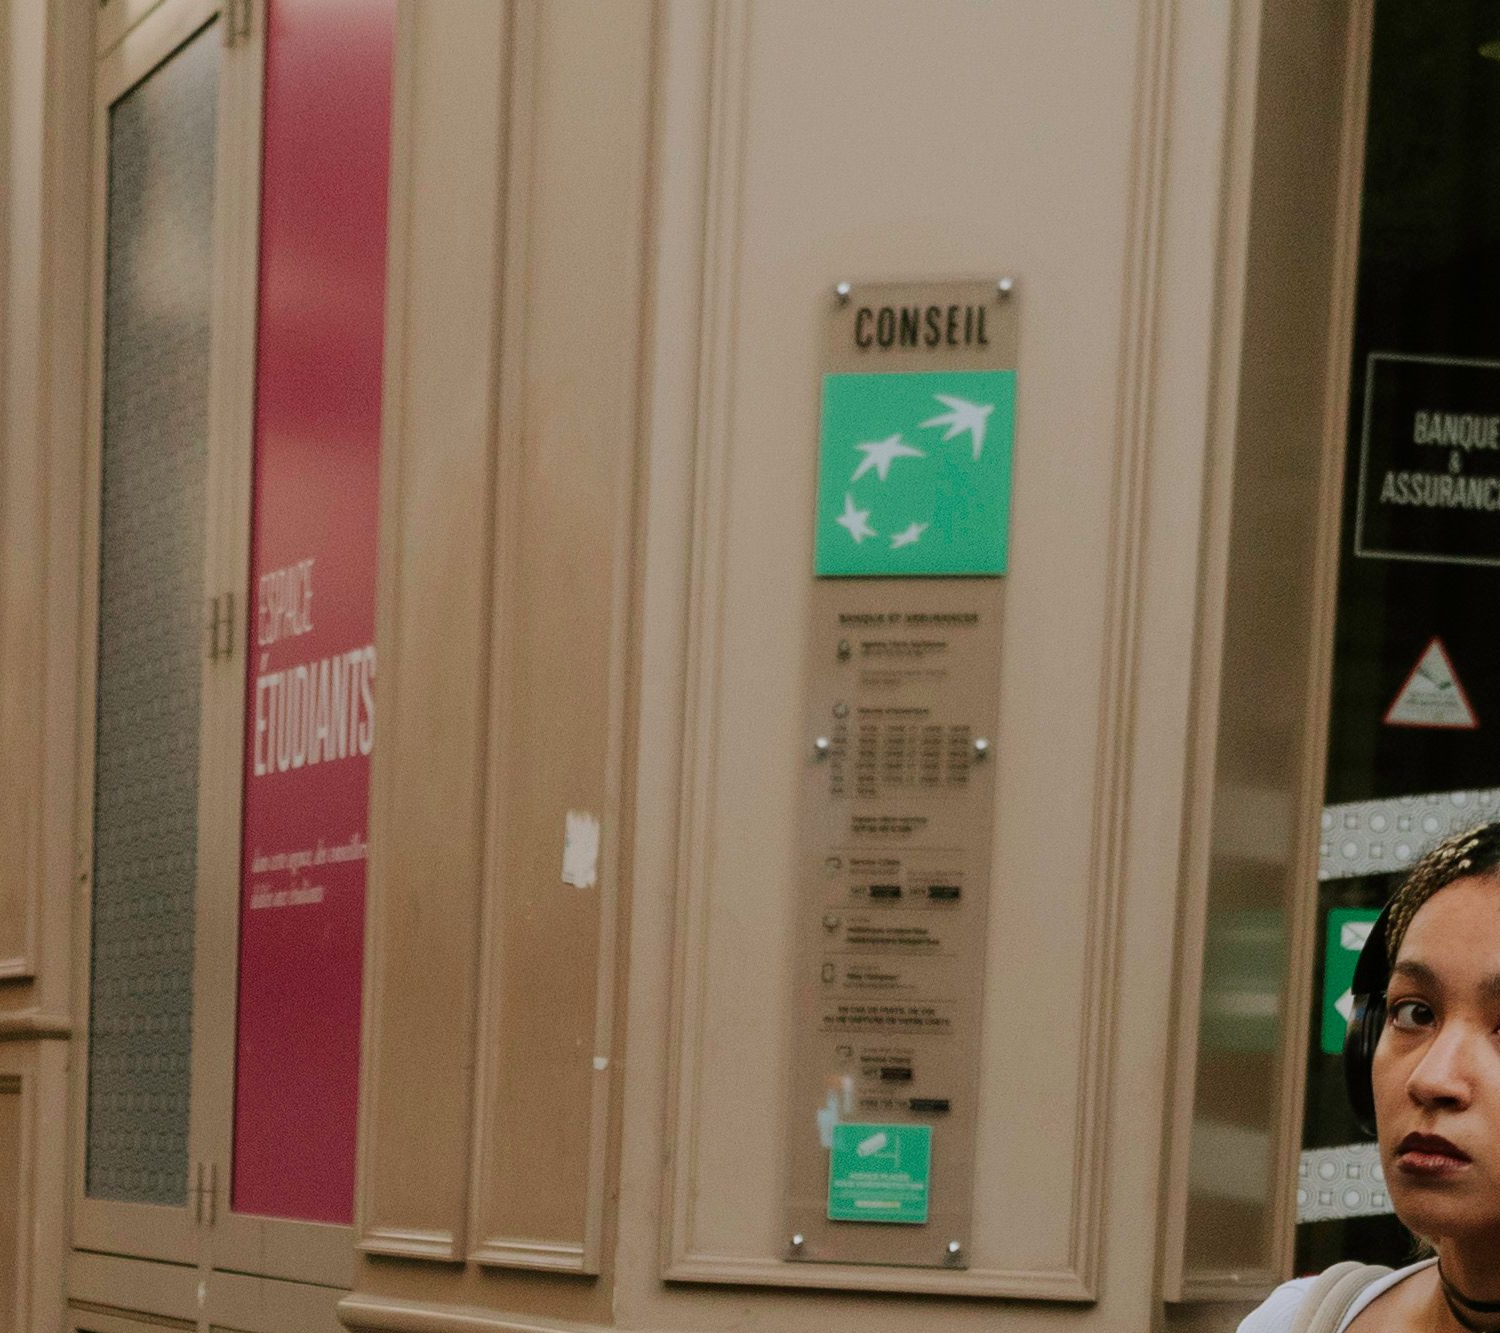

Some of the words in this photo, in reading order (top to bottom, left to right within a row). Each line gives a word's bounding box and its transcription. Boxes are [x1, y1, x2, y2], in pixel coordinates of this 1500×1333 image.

[855, 305, 989, 348] CONSEIL
[1414, 411, 1500, 452] BANQUE
[257, 558, 316, 646] ESPACE
[253, 645, 377, 778] ÉTUDIANTS
